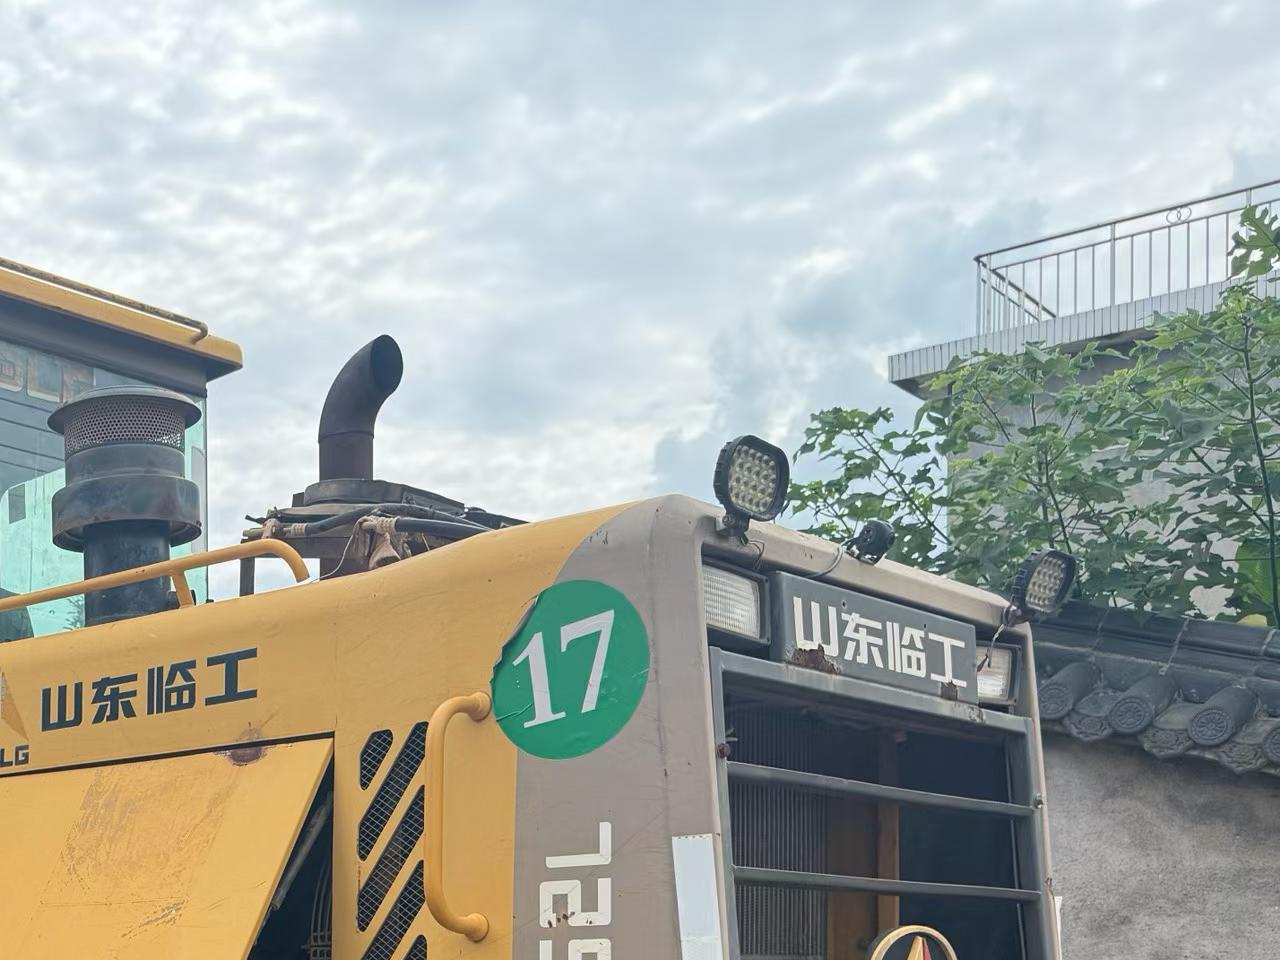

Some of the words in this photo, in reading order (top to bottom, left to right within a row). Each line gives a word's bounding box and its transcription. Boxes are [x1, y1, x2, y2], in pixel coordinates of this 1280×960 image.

[512, 609, 615, 728] 17
[793, 596, 967, 687] 山东临工
[41, 647, 258, 732] 山东临工
